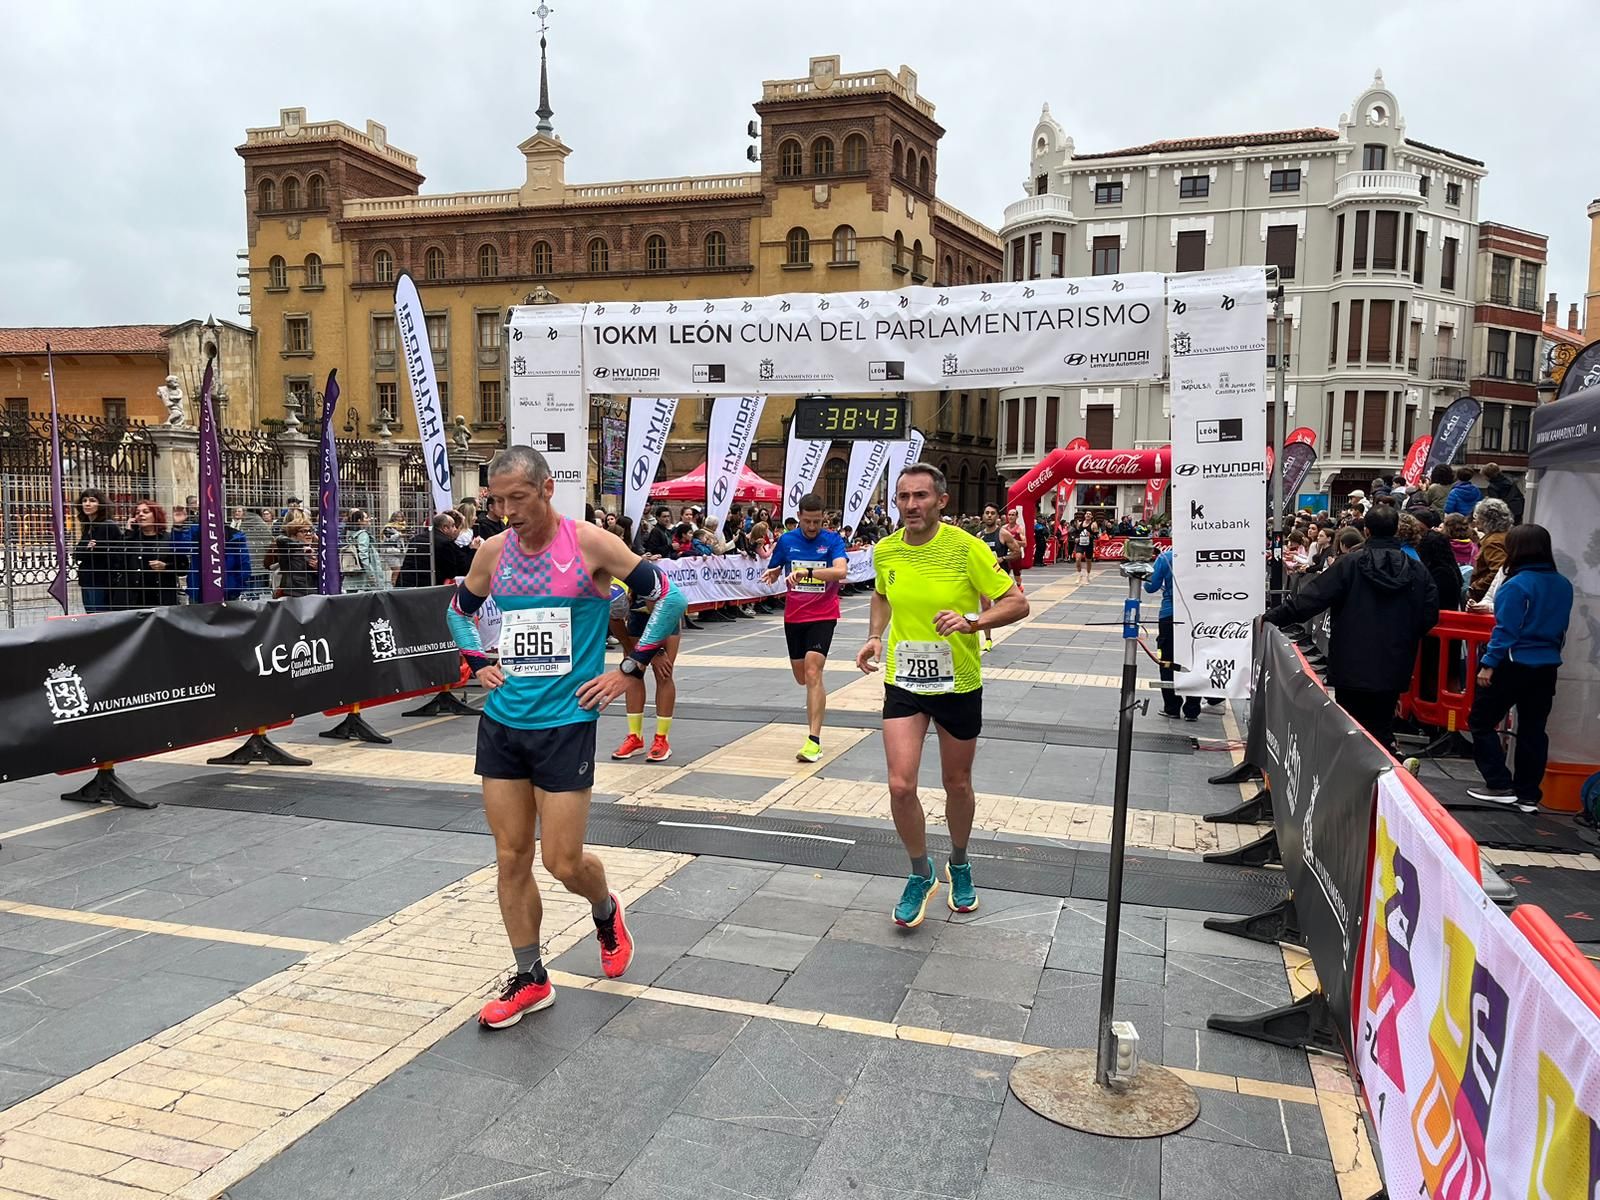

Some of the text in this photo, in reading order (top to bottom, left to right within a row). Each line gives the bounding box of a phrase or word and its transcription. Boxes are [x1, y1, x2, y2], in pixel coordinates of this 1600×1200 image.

[593, 302, 1151, 346] 10KM LEÓN CUNA DEL PARLAMENTARISMO
[1090, 350, 1150, 363] HYUNDAI
[1192, 344, 1239, 354] AYUNTAMIENTO
[1249, 341, 1265, 350] LEÓN
[612, 368, 660, 377] HYUNDAI
[642, 398, 668, 452] HYUN
[1200, 426, 1218, 434] LEÓN
[1536, 423, 1588, 444] WWW.KAMARINY.COM
[654, 416, 670, 455] Lemauto
[722, 397, 752, 473] HYUNDA
[731, 442, 746, 475] Lemauto
[742, 395, 760, 442] Automoción
[798, 440, 820, 479] HYUN
[1075, 453, 1144, 474] Coca-Cola
[1202, 461, 1264, 474] HYUNDAI
[551, 470, 581, 479] UNDAI
[1027, 466, 1054, 493] Coca-Cola
[1228, 470, 1264, 478] Automoción
[1190, 520, 1250, 530] kutxabank
[208, 509, 222, 588] ALTAFIT
[1193, 588, 1248, 601] emico
[1191, 621, 1252, 640] Coca-Cola
[440, 642, 447, 650] DE
[447, 640, 458, 648] LEÓ
[514, 632, 553, 656] 696
[290, 660, 303, 670] Cuna
[290, 662, 334, 679] Parlamentarismo
[907, 658, 940, 678] 288
[1206, 659, 1235, 670] KAM
[1211, 680, 1228, 690] NY
[92, 682, 216, 712] AYUNTAMIENTO DE LEÓN
